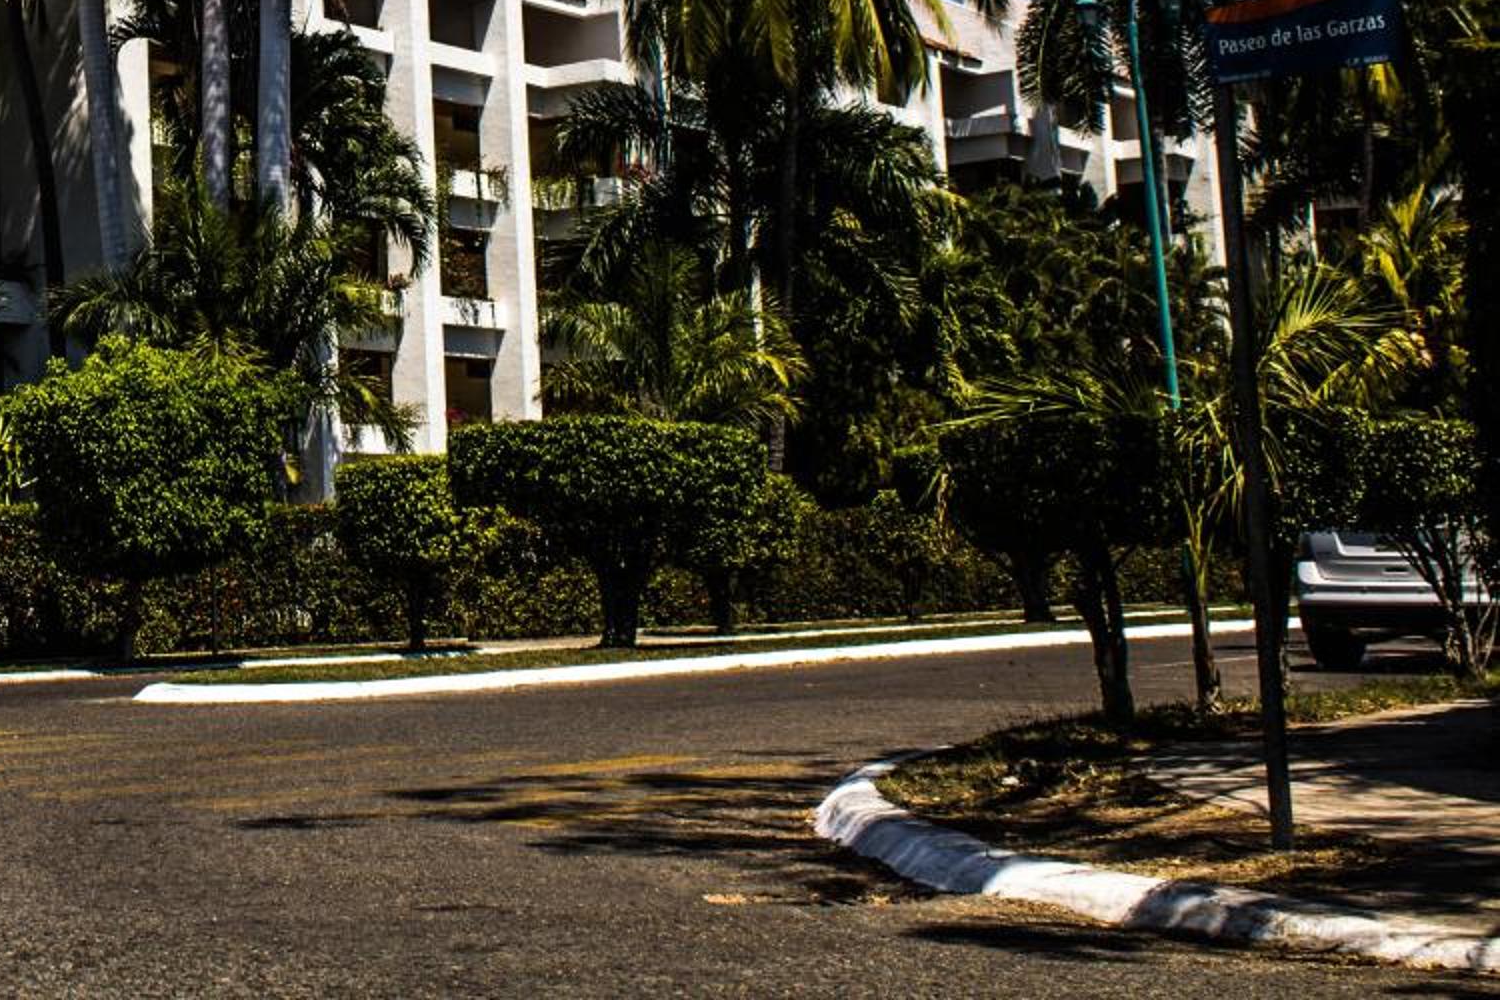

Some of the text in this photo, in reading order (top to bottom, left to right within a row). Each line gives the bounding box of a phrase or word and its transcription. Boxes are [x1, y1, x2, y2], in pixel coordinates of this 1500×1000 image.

[1219, 14, 1386, 56] Paseo de las Garzas
